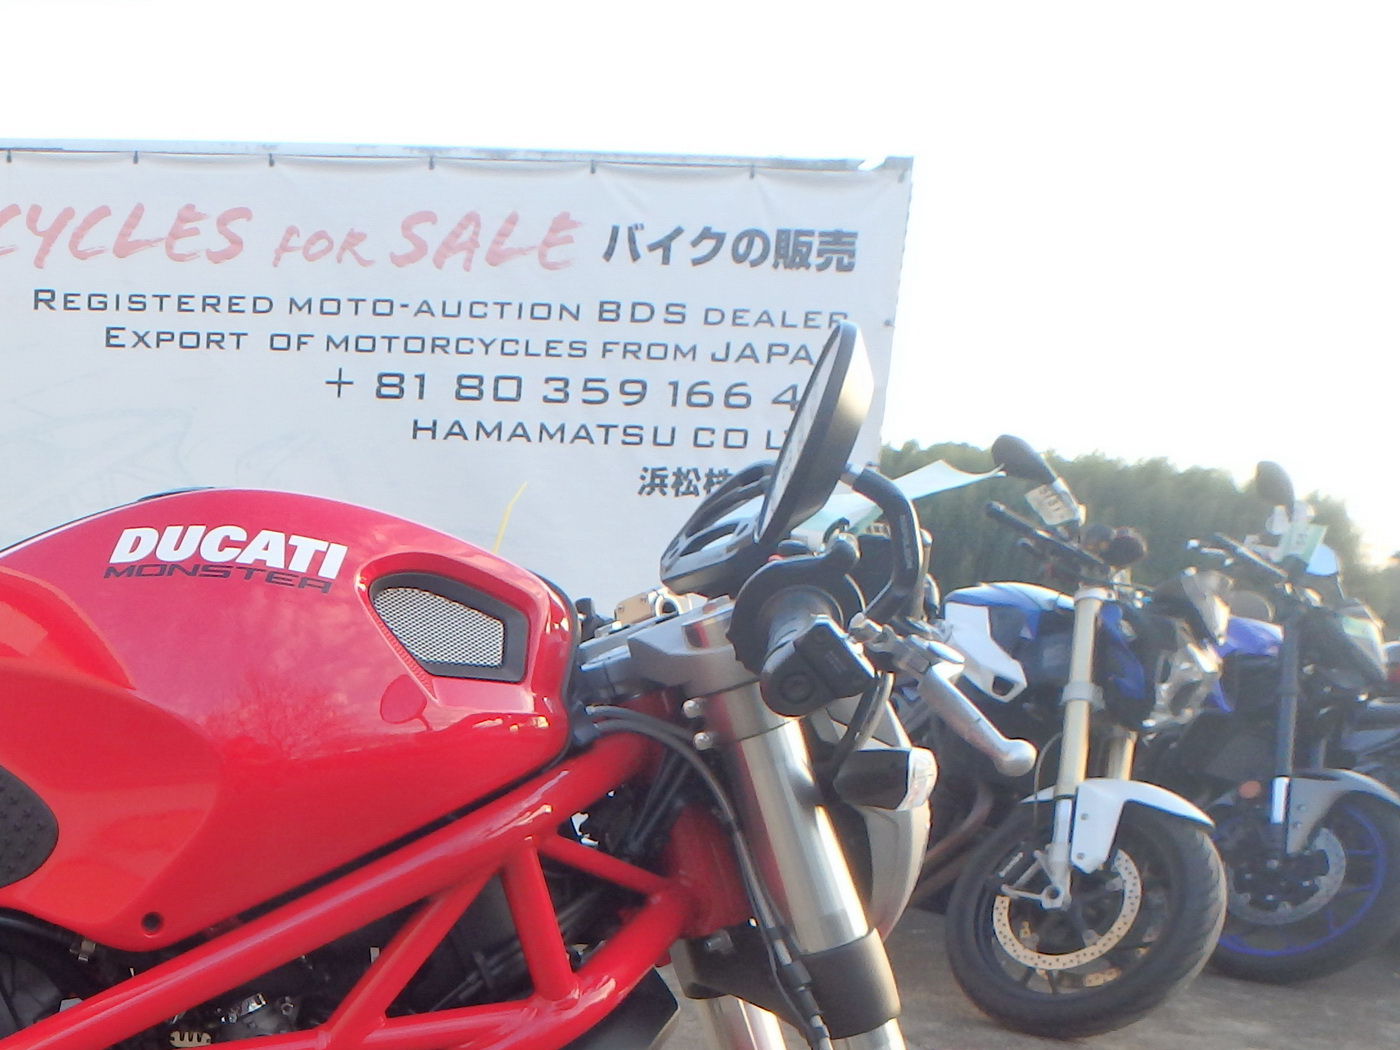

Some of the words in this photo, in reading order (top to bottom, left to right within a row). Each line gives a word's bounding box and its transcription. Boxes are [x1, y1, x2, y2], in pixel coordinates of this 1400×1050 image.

[272, 225, 375, 268] FOR
[390, 211, 583, 274] SALE
[603, 224, 860, 274] バイクの販売
[34, 288, 274, 315] REGISTERED
[289, 297, 582, 323] MOTO-AUCTION
[598, 301, 688, 326] BDS
[105, 327, 249, 351] EXPORT
[270, 334, 316, 353] OF
[326, 335, 588, 360] MOTORCYCLES
[602, 342, 698, 363] FROM
[710, 341, 815, 366] JAPA
[376, 373, 427, 402] 81
[455, 374, 524, 404] 80
[413, 419, 677, 448] HAMAMATSU
[693, 427, 749, 450] CO
[108, 525, 349, 580] DUCATI
[103, 563, 335, 594] MONSTER
